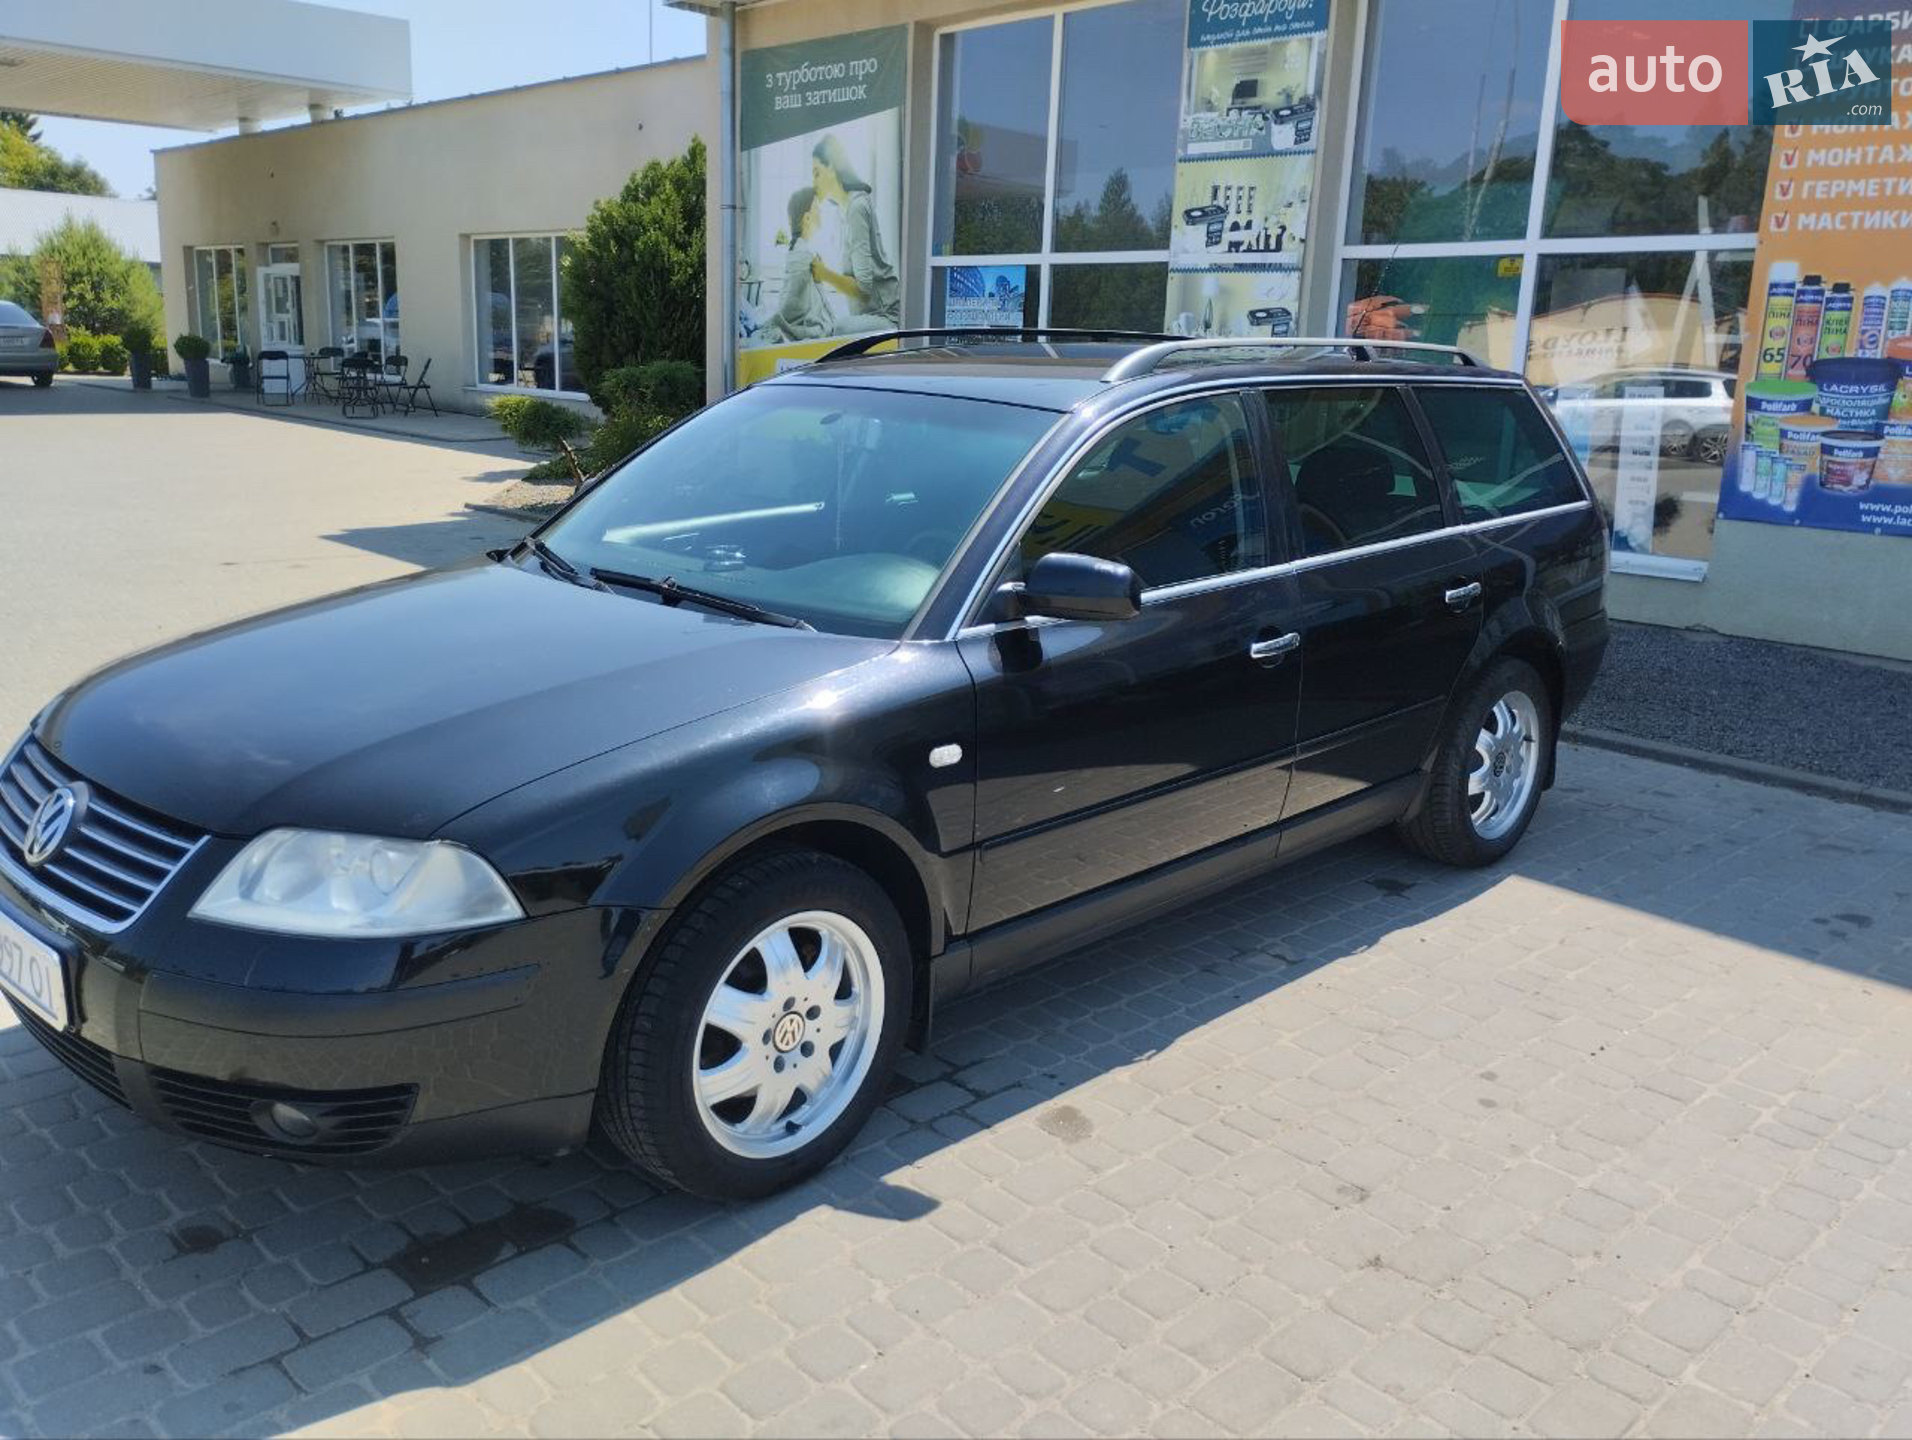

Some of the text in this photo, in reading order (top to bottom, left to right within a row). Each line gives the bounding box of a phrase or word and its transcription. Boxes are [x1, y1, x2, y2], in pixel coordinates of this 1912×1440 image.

[776, 61, 846, 92] турботою
[849, 57, 878, 81] про
[774, 84, 867, 110] ваш затишок
[1762, 347, 1786, 363] 65
[1786, 430, 1818, 442] Polifa
